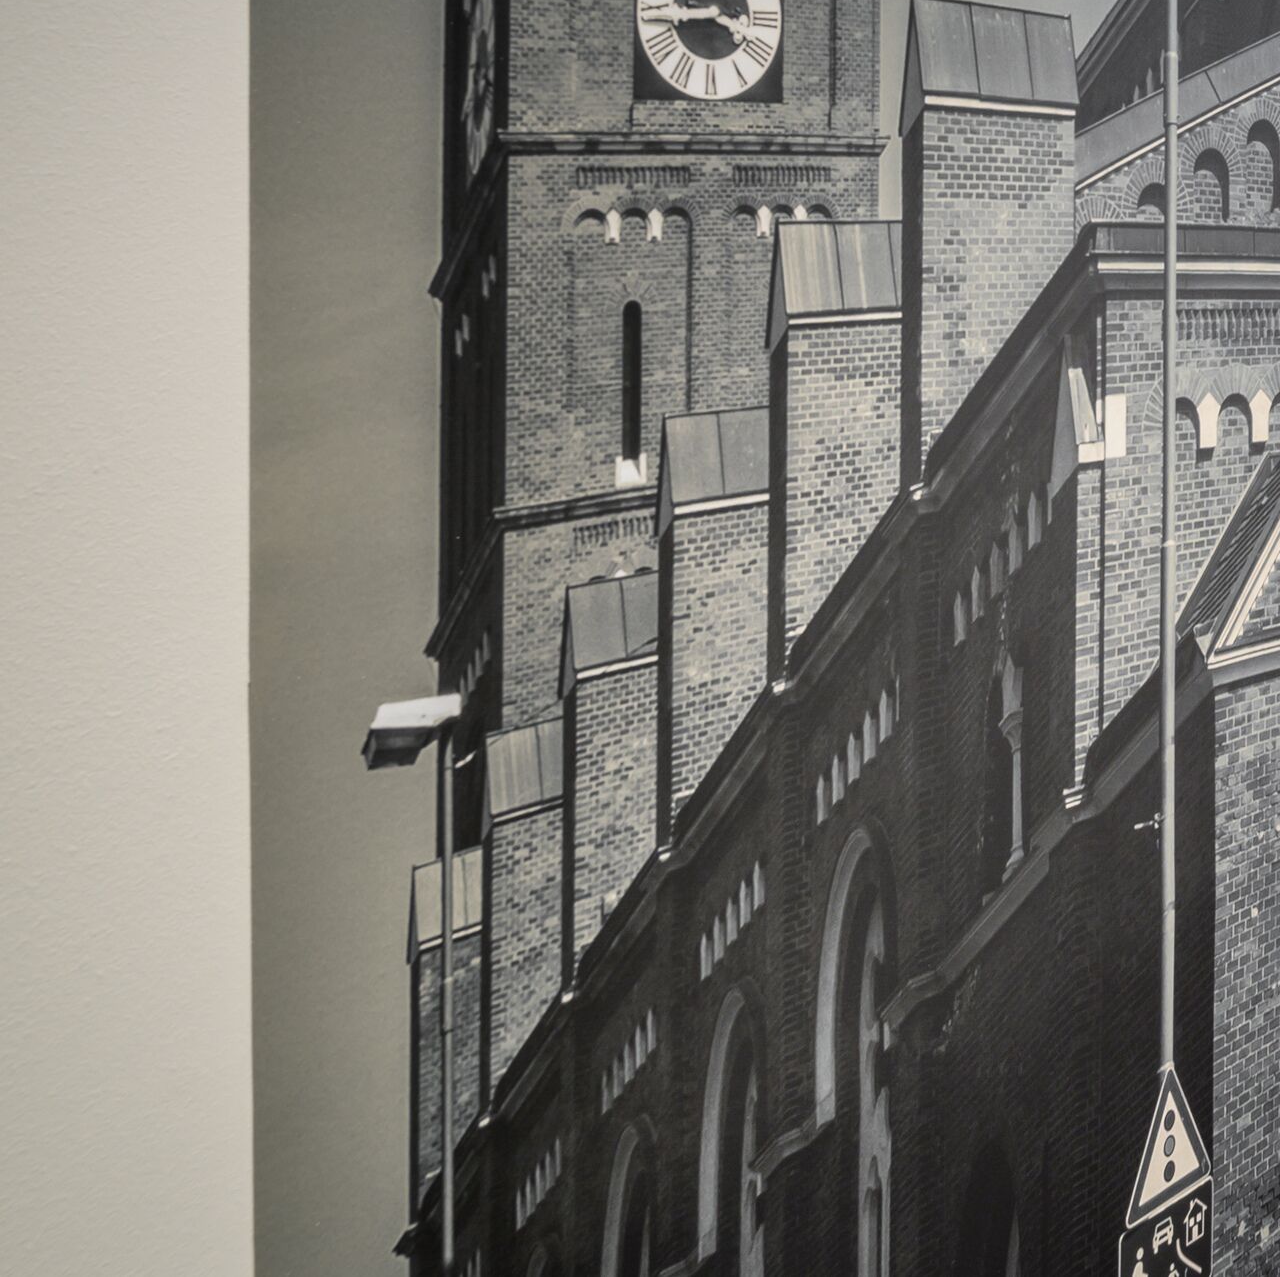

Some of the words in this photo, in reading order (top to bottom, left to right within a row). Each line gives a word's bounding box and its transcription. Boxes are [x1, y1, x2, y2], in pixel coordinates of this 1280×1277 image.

[752, 11, 778, 29] III
[645, 27, 679, 66] VIII
[669, 52, 695, 89] VII
[705, 64, 717, 96] VI
